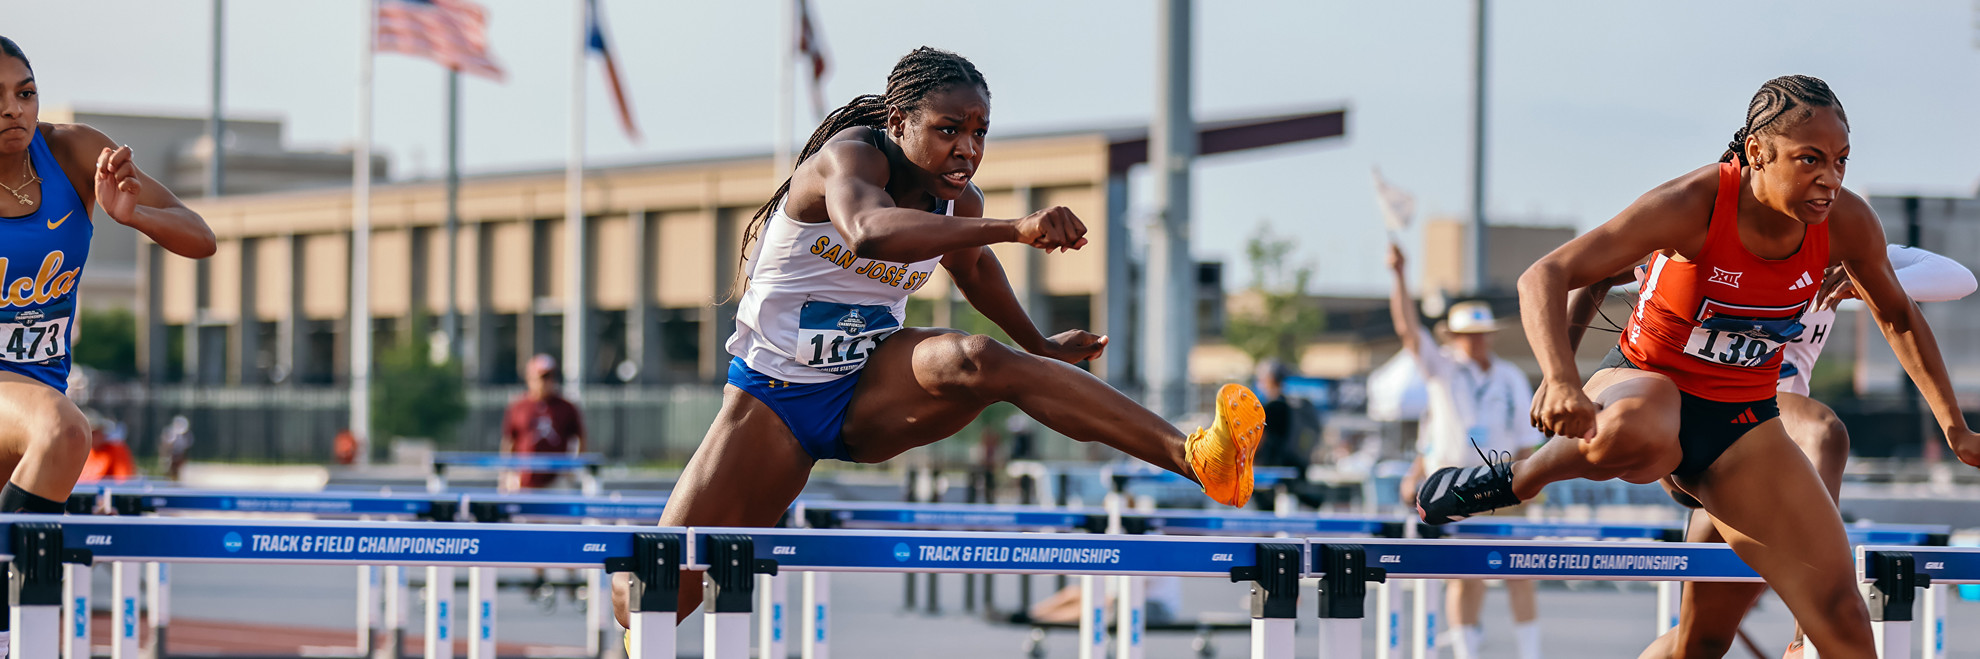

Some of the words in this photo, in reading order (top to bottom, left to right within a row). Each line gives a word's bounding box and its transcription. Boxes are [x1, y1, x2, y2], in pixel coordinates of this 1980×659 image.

[810, 235, 858, 270] SAN
[855, 260, 910, 288] JOSÉ
[0, 323, 60, 360] 473
[1697, 328, 1768, 365] 139
[85, 535, 112, 545] GILL
[252, 534, 299, 552] TRACK
[301, 535, 313, 552] &
[314, 535, 355, 553] FIELD
[357, 536, 480, 555] CHAMPIONSHIPS
[582, 543, 607, 552] GILL
[772, 545, 796, 555] GILL
[919, 545, 961, 562] TRACK
[962, 546, 972, 562] &
[973, 546, 1010, 562] FIELD
[1012, 547, 1121, 564] CHAMPIONSHIPS
[1211, 553, 1233, 562] GILL
[1379, 554, 1401, 563] GILL
[1509, 553, 1548, 569] TRACK
[1548, 554, 1558, 569] &
[1558, 554, 1591, 569] FIELD
[1592, 555, 1689, 571] CHAMPIONSHIPS
[1924, 561, 1945, 570] GILL
